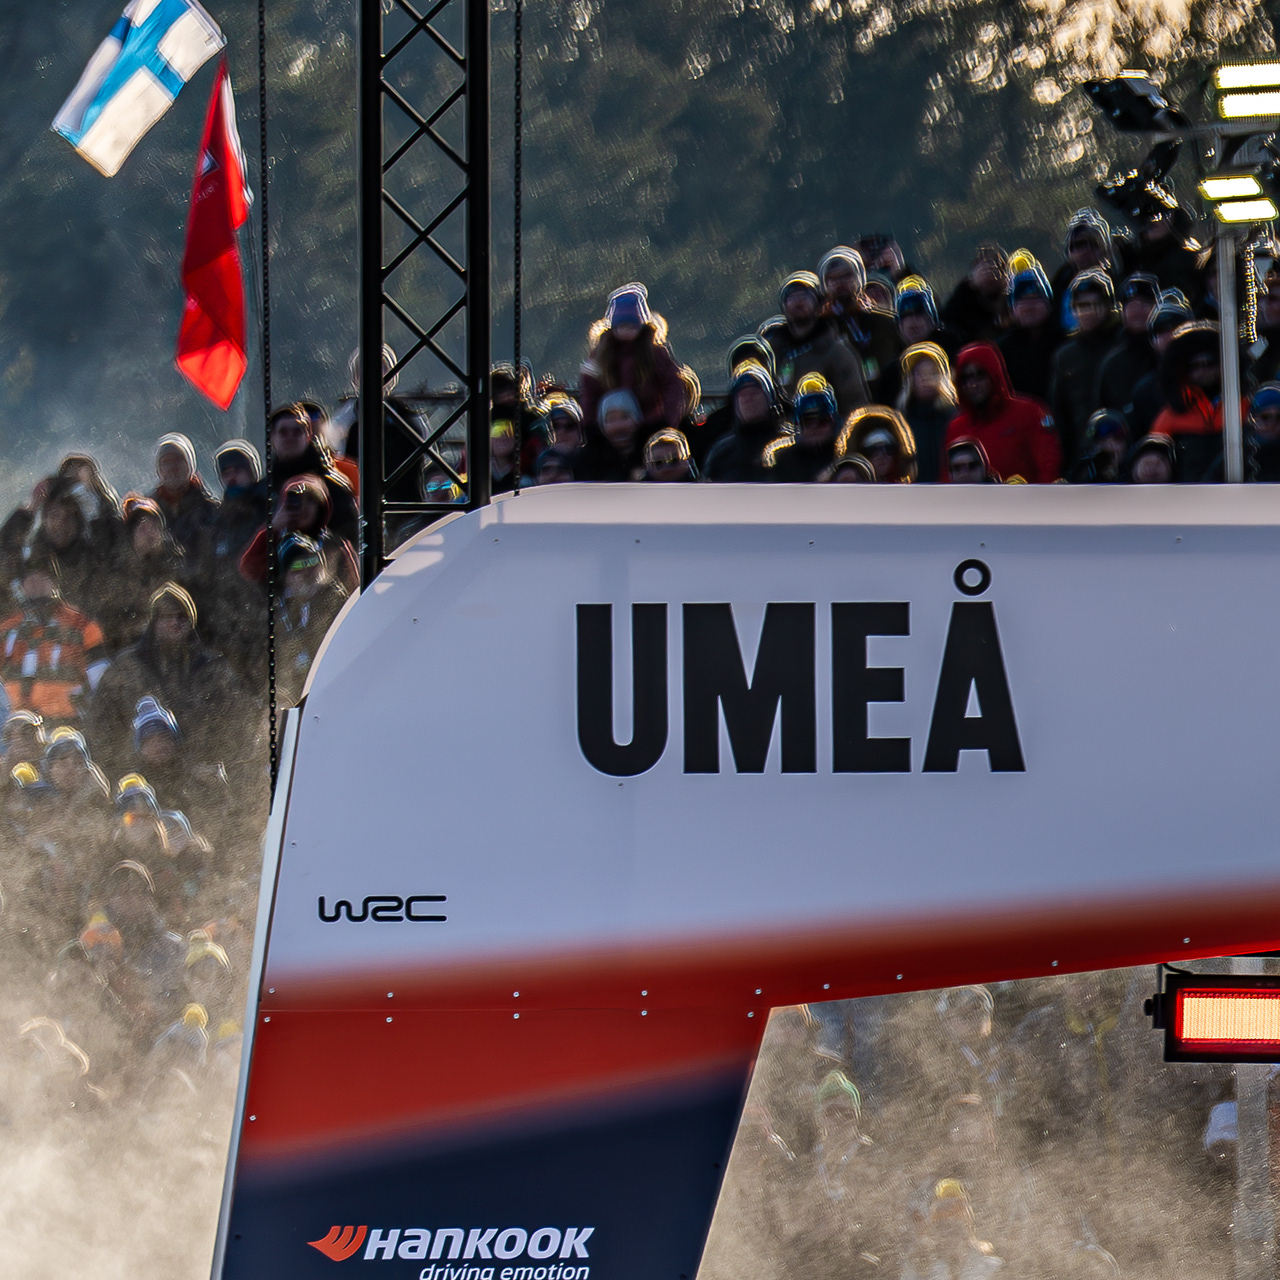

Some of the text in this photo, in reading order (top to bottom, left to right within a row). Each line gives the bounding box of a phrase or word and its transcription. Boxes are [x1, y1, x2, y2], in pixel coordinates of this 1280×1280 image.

[576, 559, 1026, 777] UMEÅ
[318, 895, 447, 923] WRC
[499, 1263, 590, 1280] emotion
